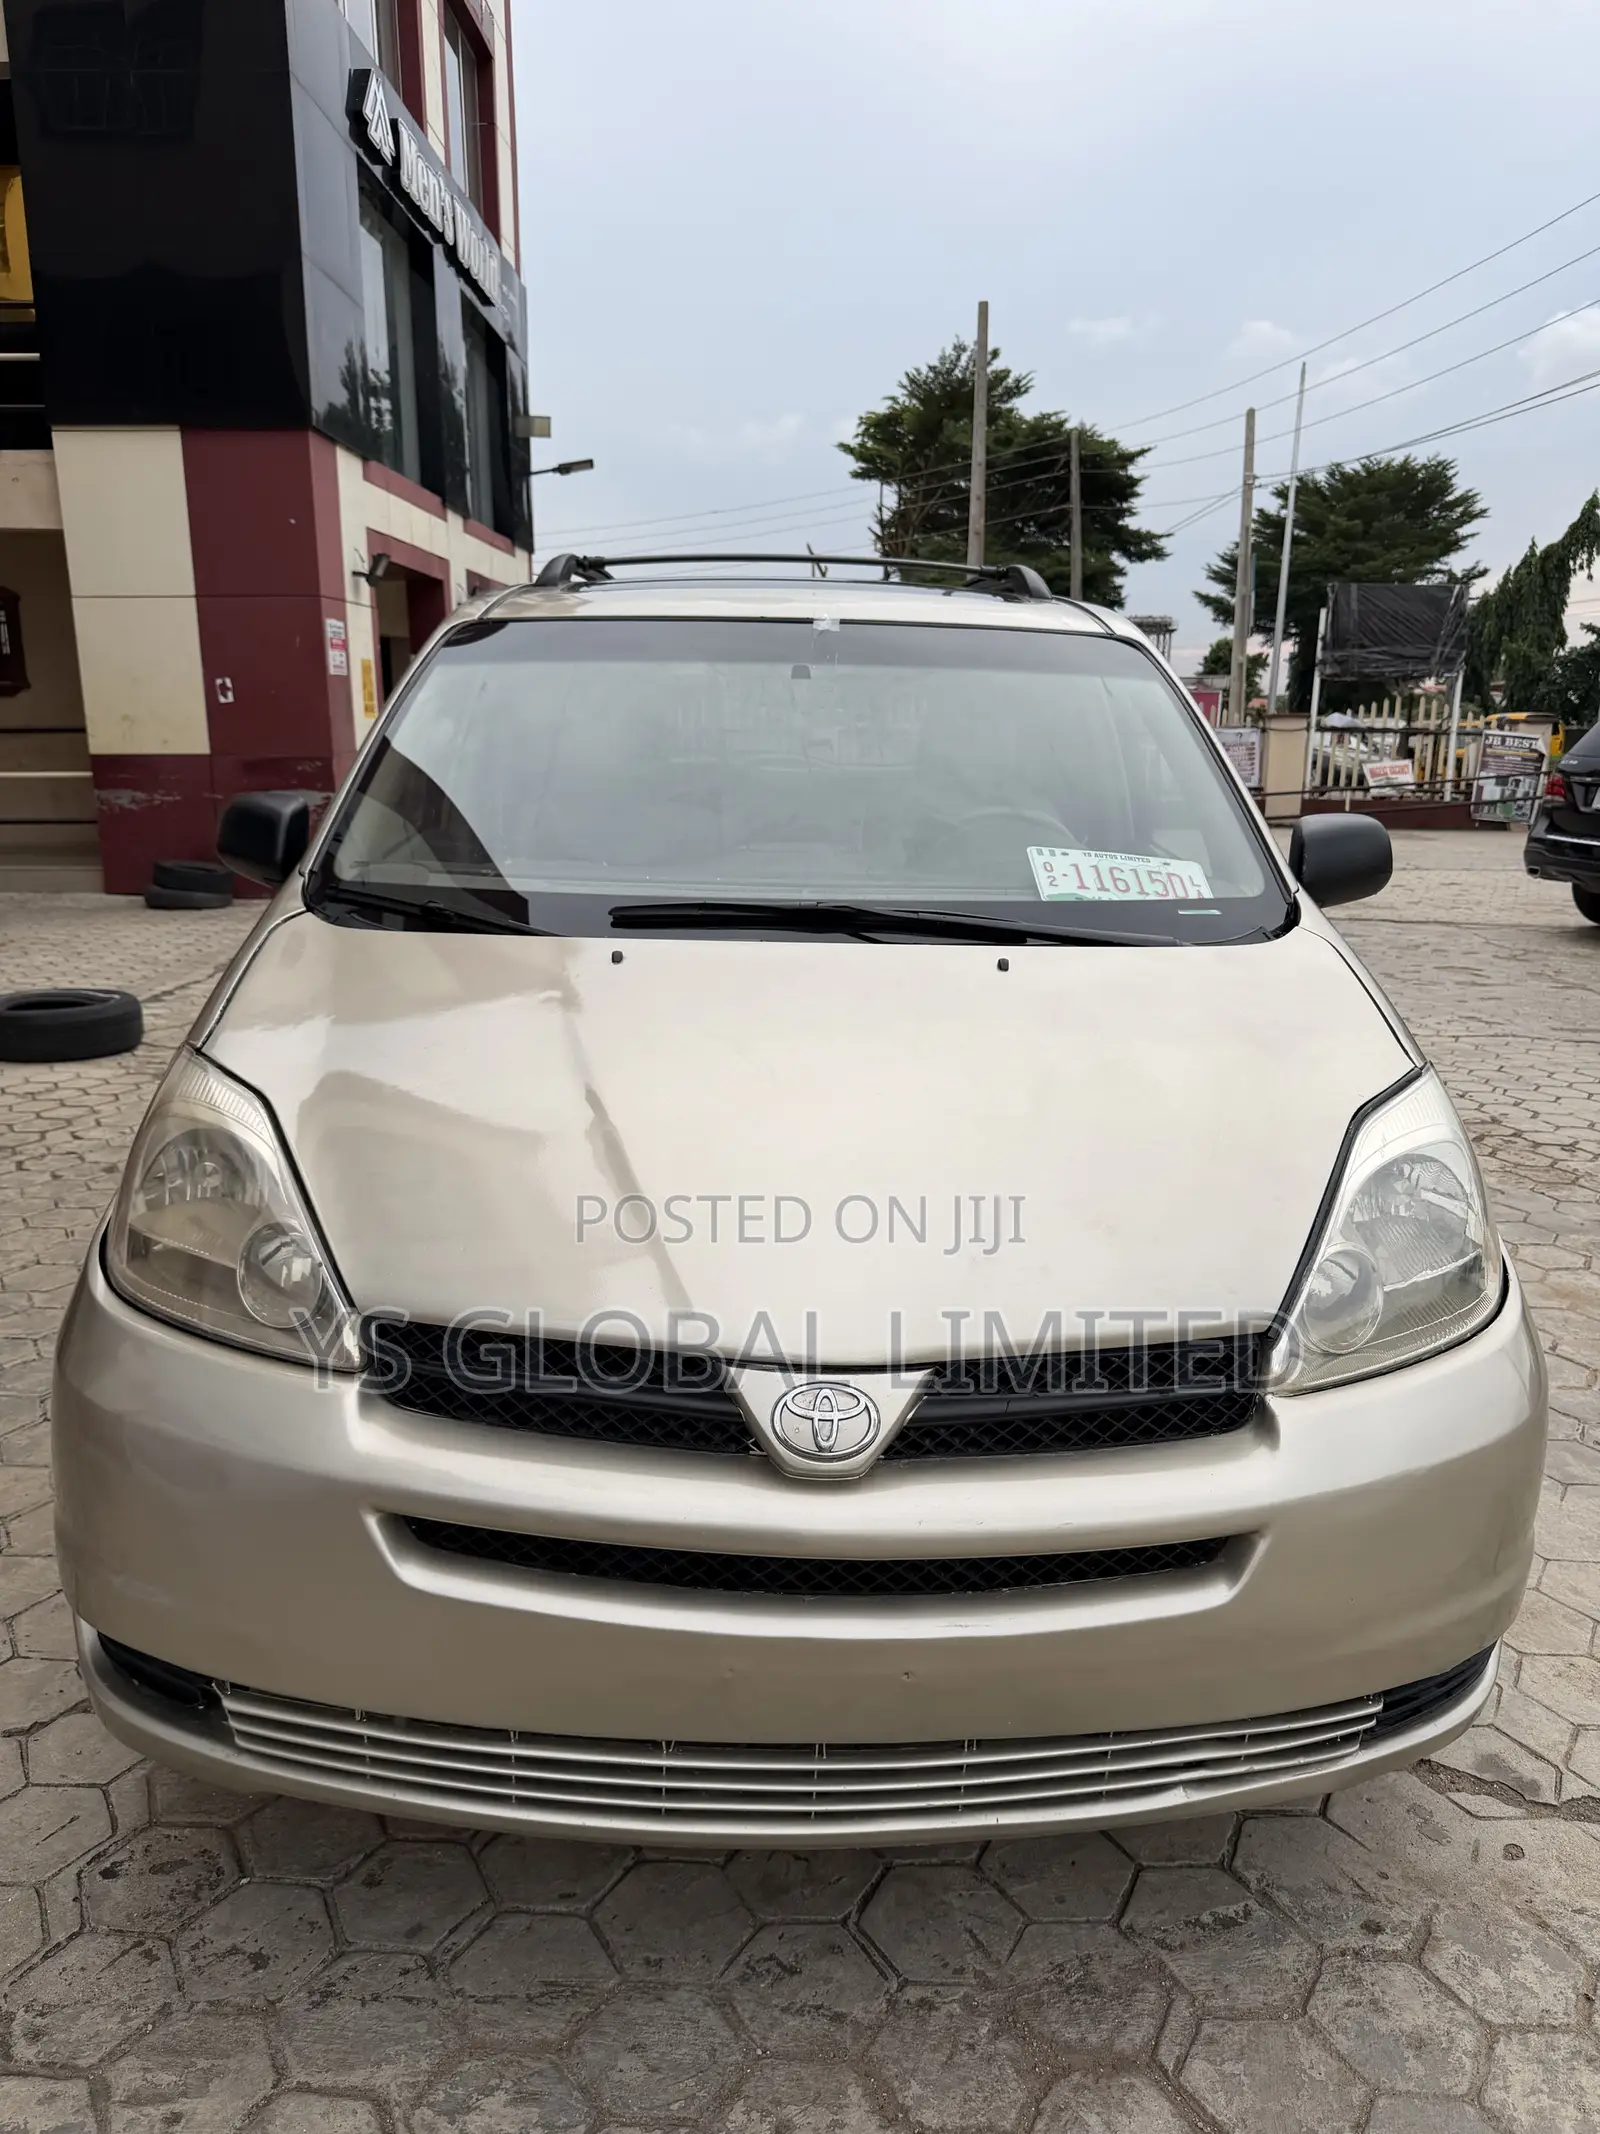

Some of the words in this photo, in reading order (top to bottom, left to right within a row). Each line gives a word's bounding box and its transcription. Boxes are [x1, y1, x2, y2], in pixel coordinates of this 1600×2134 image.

[398, 117, 455, 246] Men's
[1094, 852, 1119, 860] AUTOS
[1120, 855, 1151, 864] LIMITED
